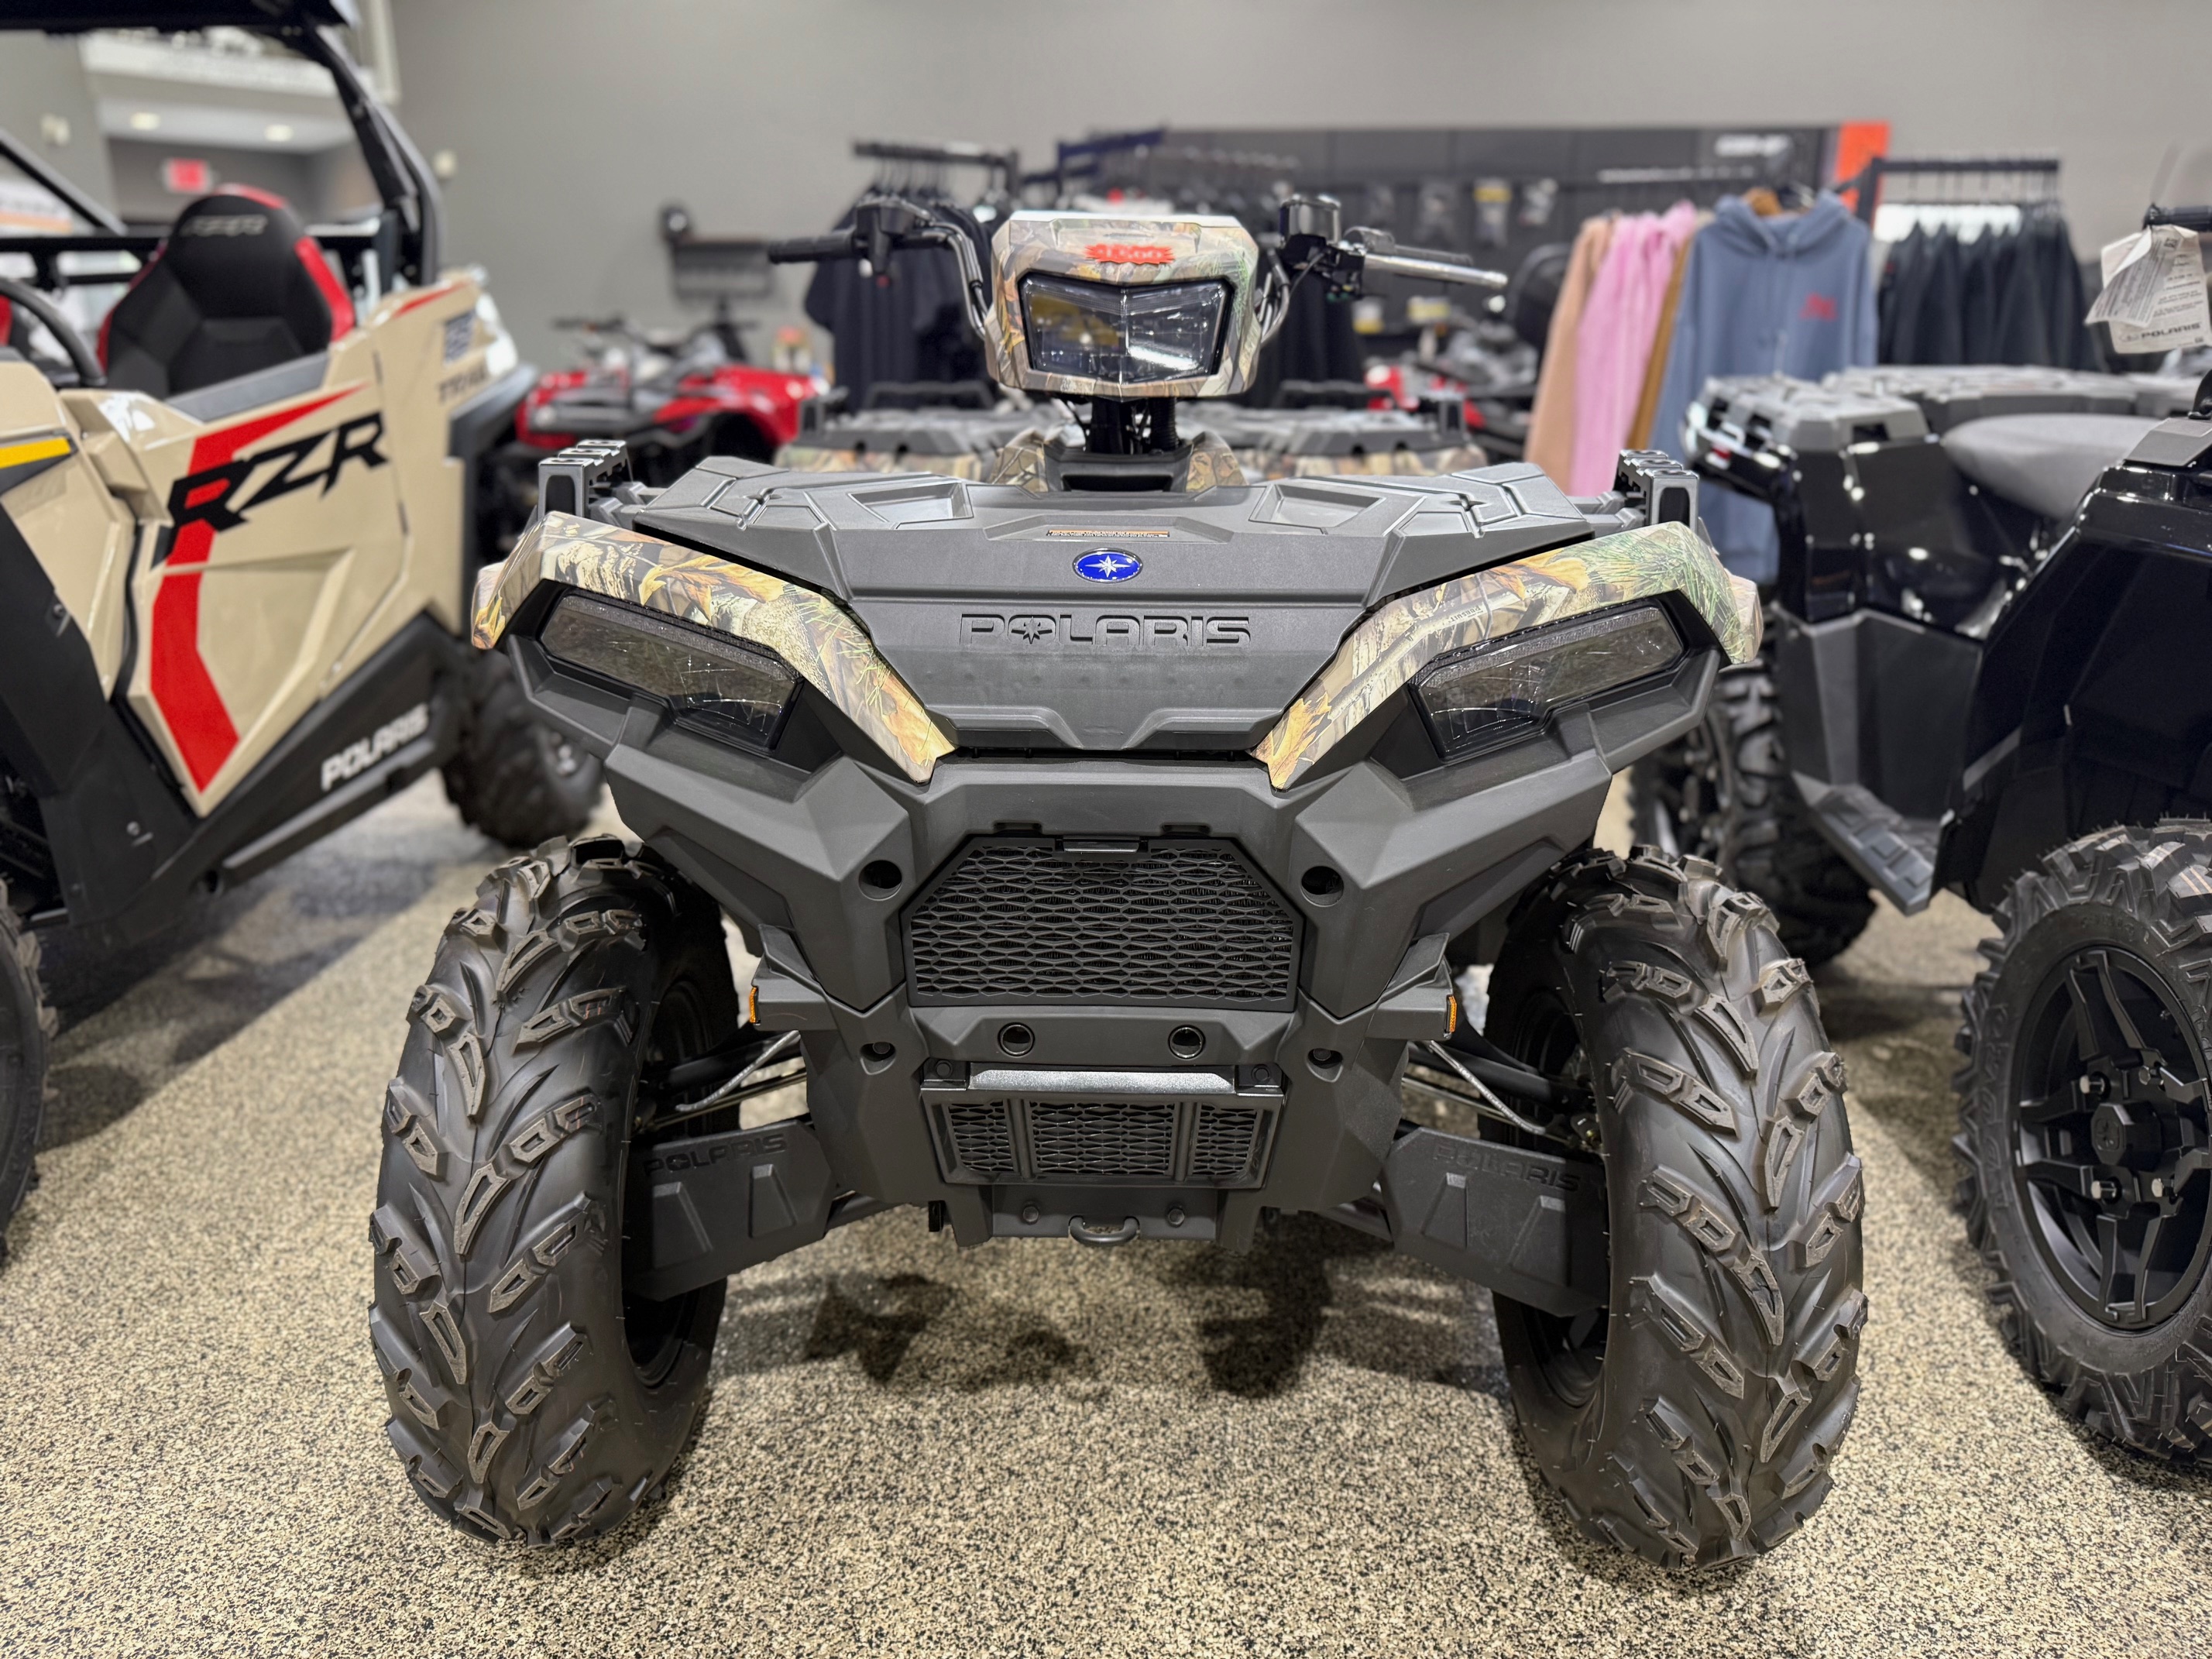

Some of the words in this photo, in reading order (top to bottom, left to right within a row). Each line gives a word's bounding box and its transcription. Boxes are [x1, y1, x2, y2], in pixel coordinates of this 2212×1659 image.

[166, 408, 390, 559] RZR
[960, 614, 1252, 646] POLARIS
[1449, 605, 1482, 622] PURSUIT
[321, 702, 429, 792] POLARIS
[643, 1133, 788, 1176] POLARIS
[1434, 1140, 1582, 1192] POLARIS
